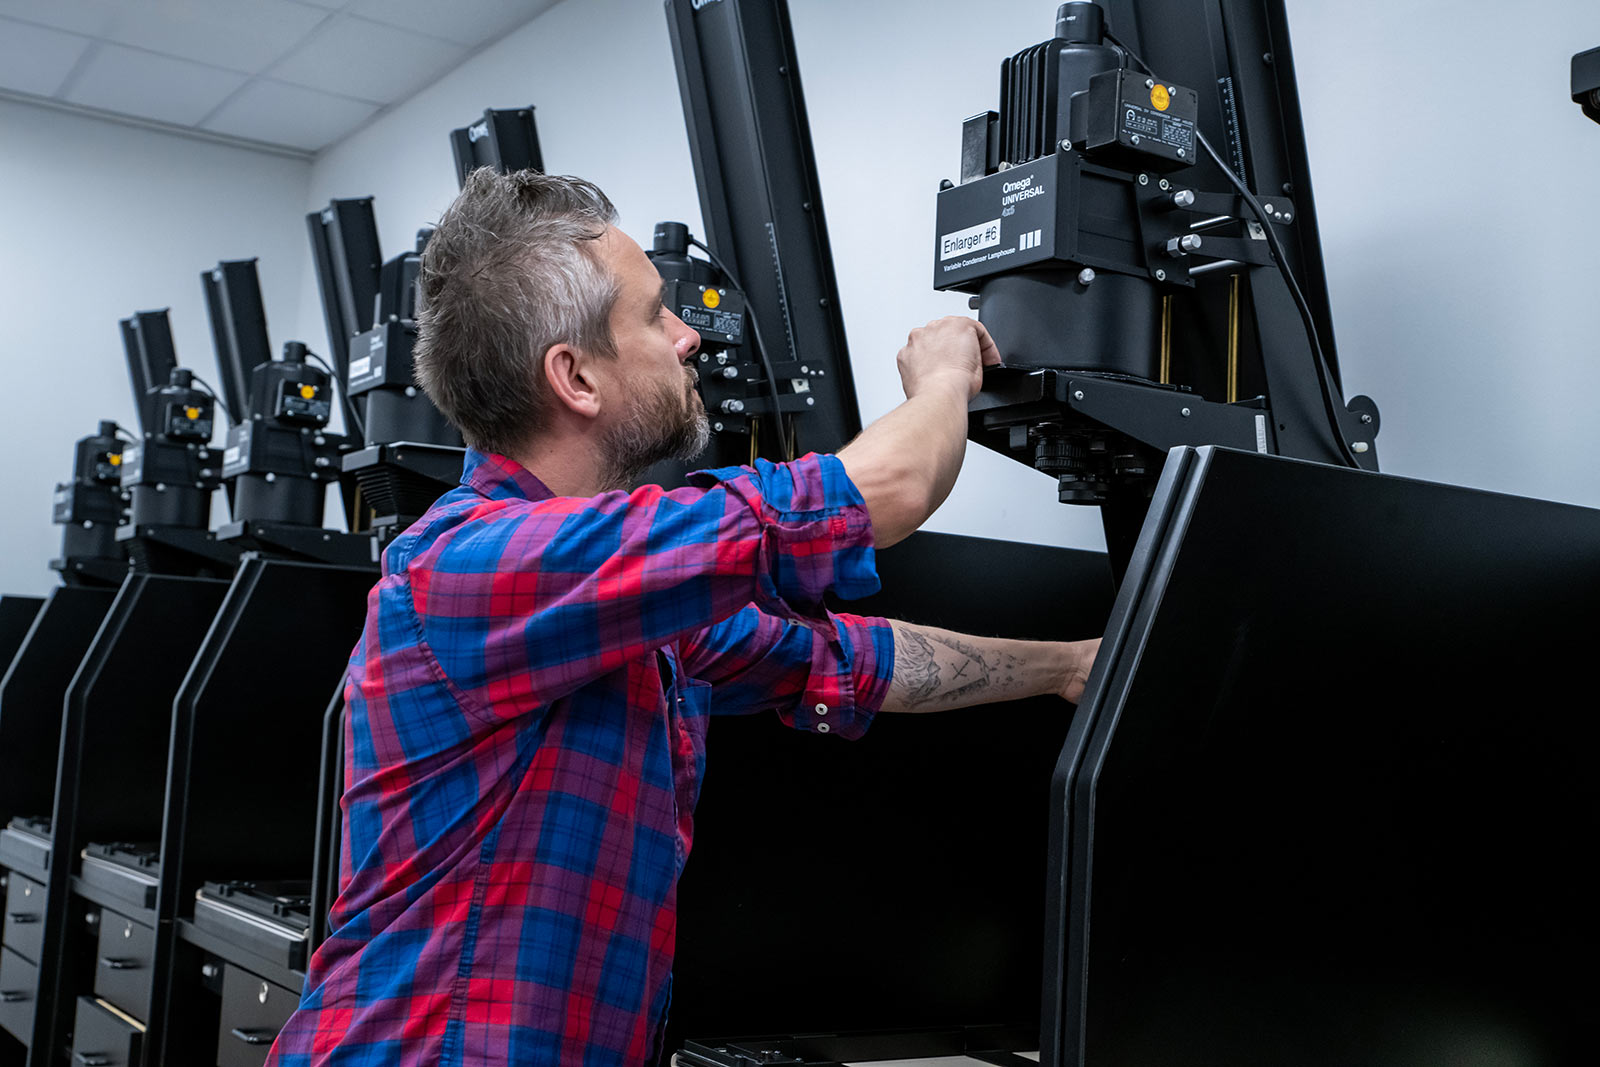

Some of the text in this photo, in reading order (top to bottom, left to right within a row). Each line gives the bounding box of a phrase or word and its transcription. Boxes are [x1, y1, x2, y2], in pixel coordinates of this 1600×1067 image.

[1002, 177, 1031, 193] Omega
[1002, 185, 1045, 206] UNIVERSAL
[944, 225, 998, 254] Enlarger #6
[943, 247, 1016, 272] Variable Condenser Lamphouse
